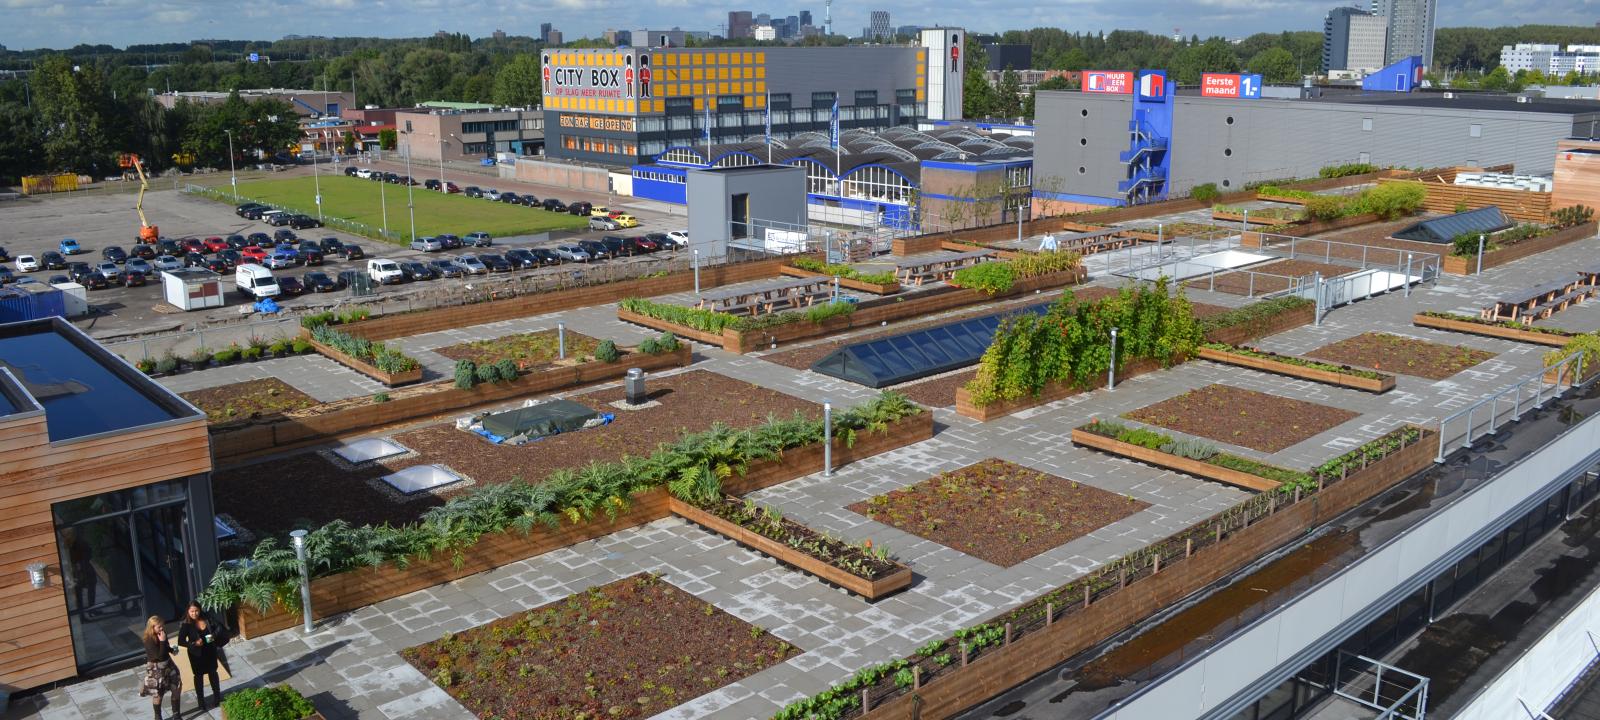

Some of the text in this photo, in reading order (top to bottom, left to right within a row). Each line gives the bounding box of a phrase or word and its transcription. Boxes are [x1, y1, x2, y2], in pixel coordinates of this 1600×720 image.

[555, 68, 619, 87] CITY BOX
[1206, 76, 1234, 86] Eerste
[555, 87, 621, 98] OP SLAG MEER RUIMTE
[1205, 86, 1236, 95] maand
